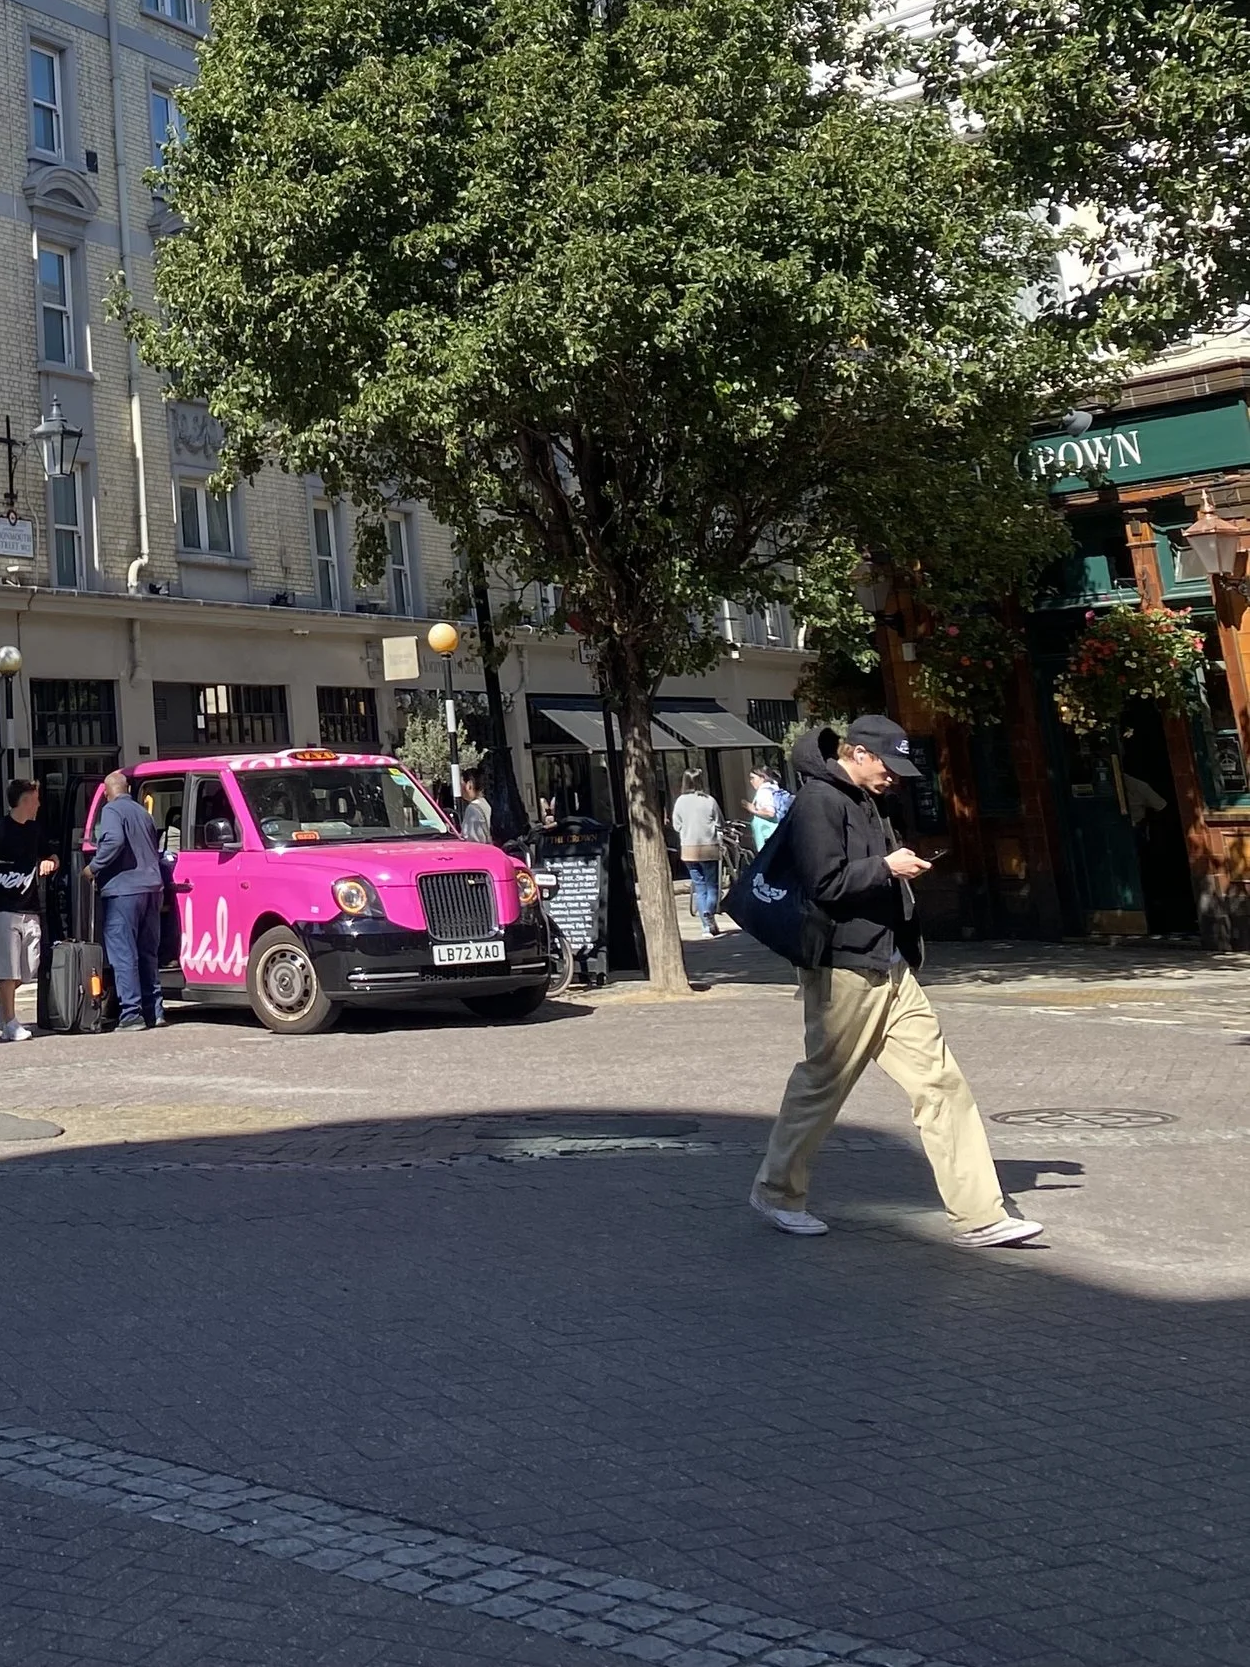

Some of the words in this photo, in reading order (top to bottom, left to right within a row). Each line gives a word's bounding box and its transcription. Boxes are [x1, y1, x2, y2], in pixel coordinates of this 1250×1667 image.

[299, 751, 334, 760] TAXI
[567, 833, 598, 843] CROWN
[438, 947, 472, 962] LB72
[475, 944, 499, 960] XAO
